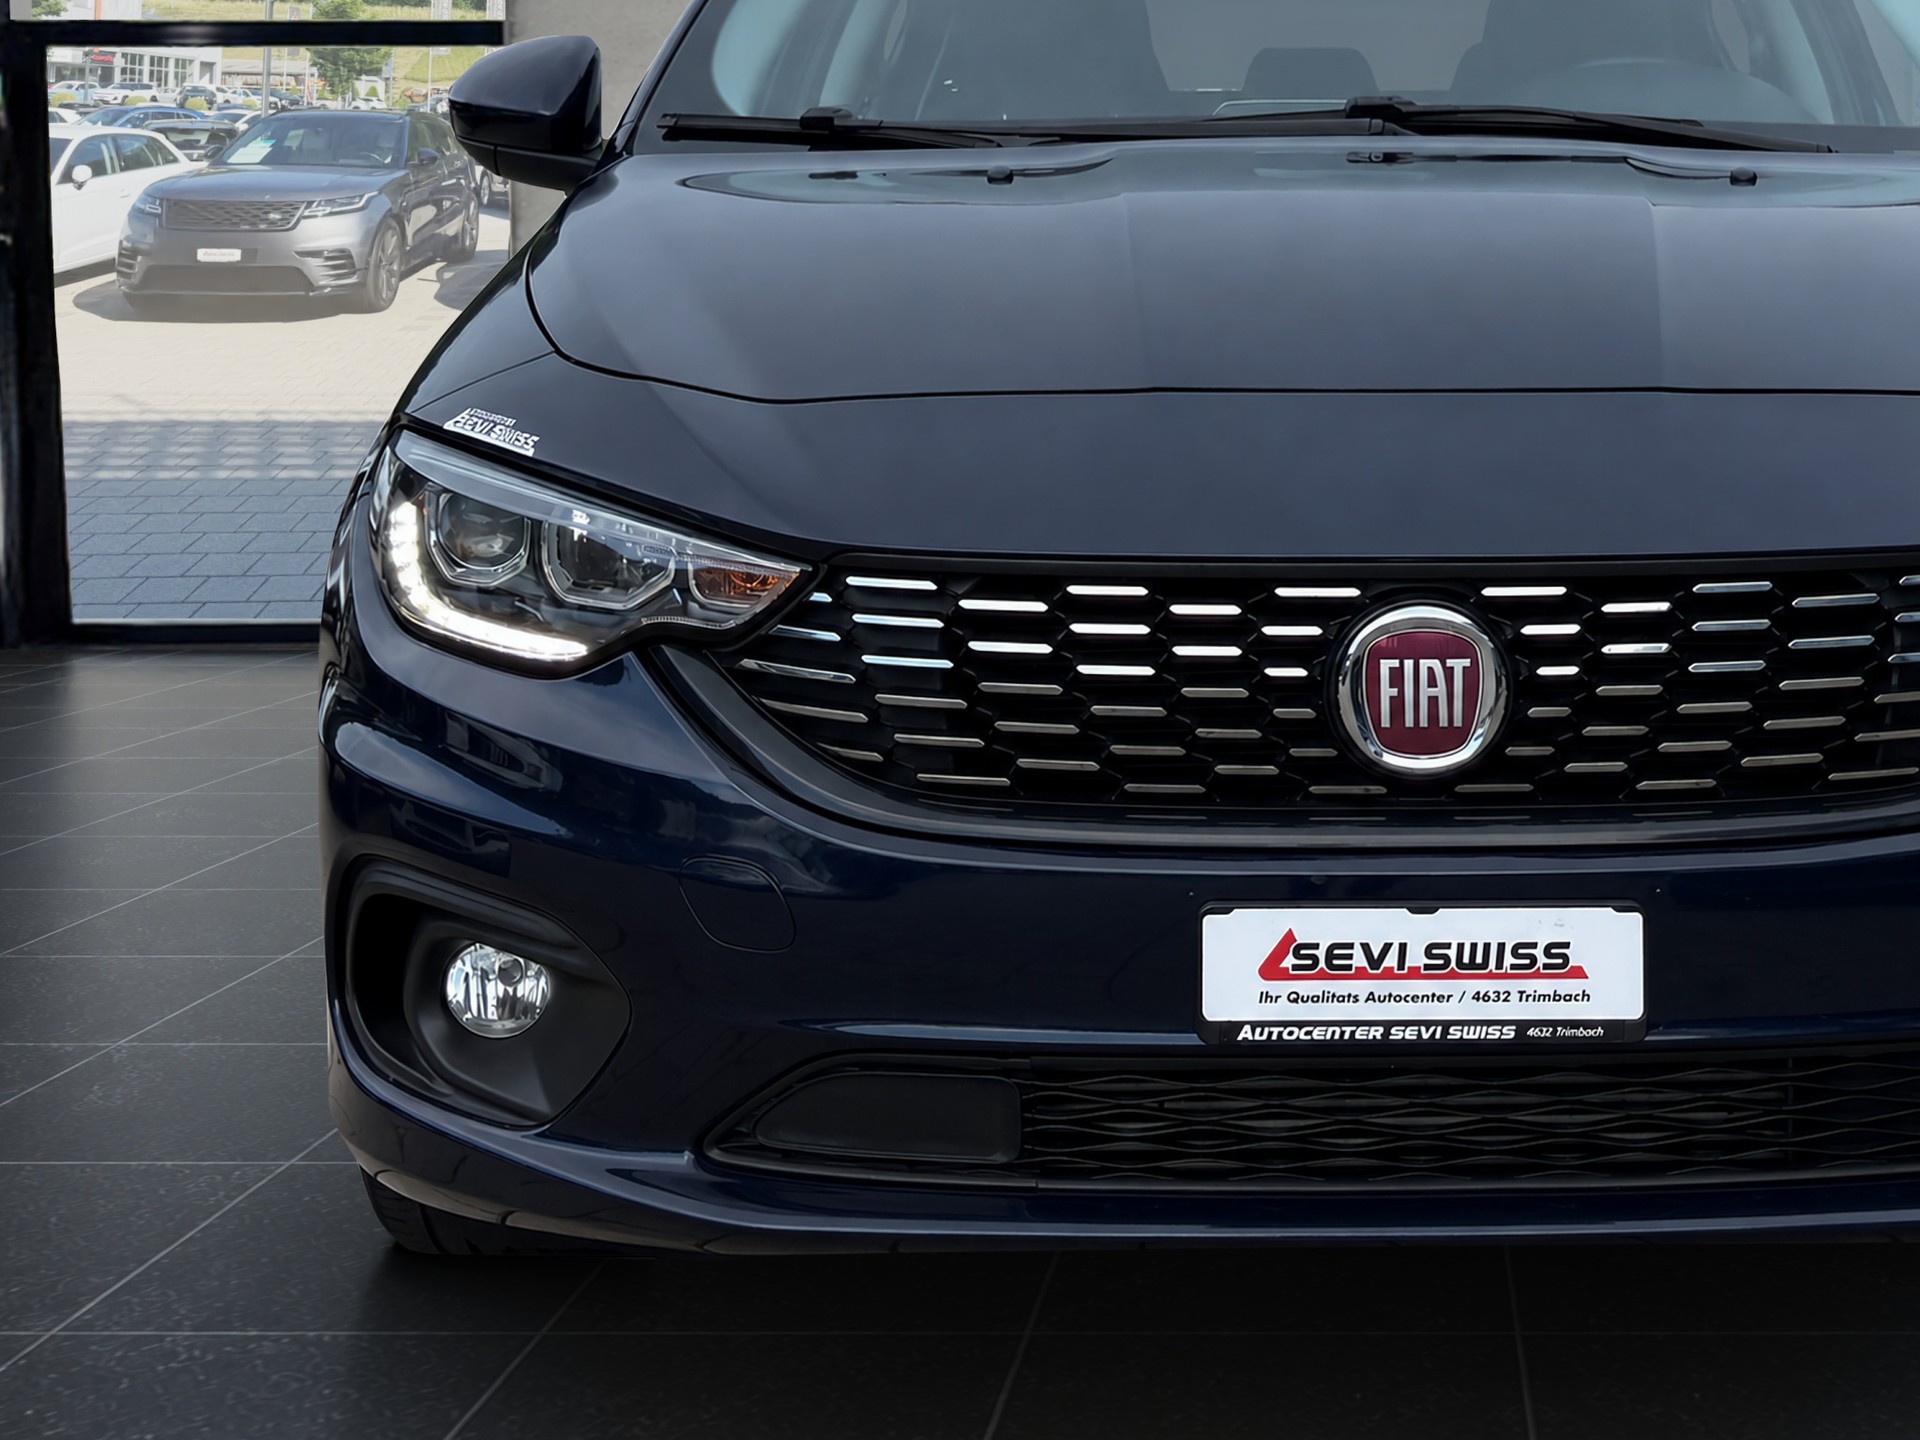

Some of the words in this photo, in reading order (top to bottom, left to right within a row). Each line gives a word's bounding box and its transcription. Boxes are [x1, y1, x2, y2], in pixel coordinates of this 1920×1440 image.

[1379, 658, 1471, 728] FIAT
[1291, 942, 1408, 972] SEVI
[1423, 941, 1571, 971] SWISS
[1258, 991, 1281, 1004] Ihr
[1287, 990, 1360, 1005] Qualitats
[1364, 991, 1453, 1004] Autocenter
[1471, 990, 1511, 1003] 4632
[1517, 989, 1591, 1003] Trimbach
[1236, 1024, 1384, 1041] AUTOCENTER
[1389, 1026, 1442, 1040] SEVI
[1446, 1025, 1516, 1040] SWISS
[1526, 1027, 1553, 1037] 4632
[1556, 1026, 1604, 1037] Trimbach
